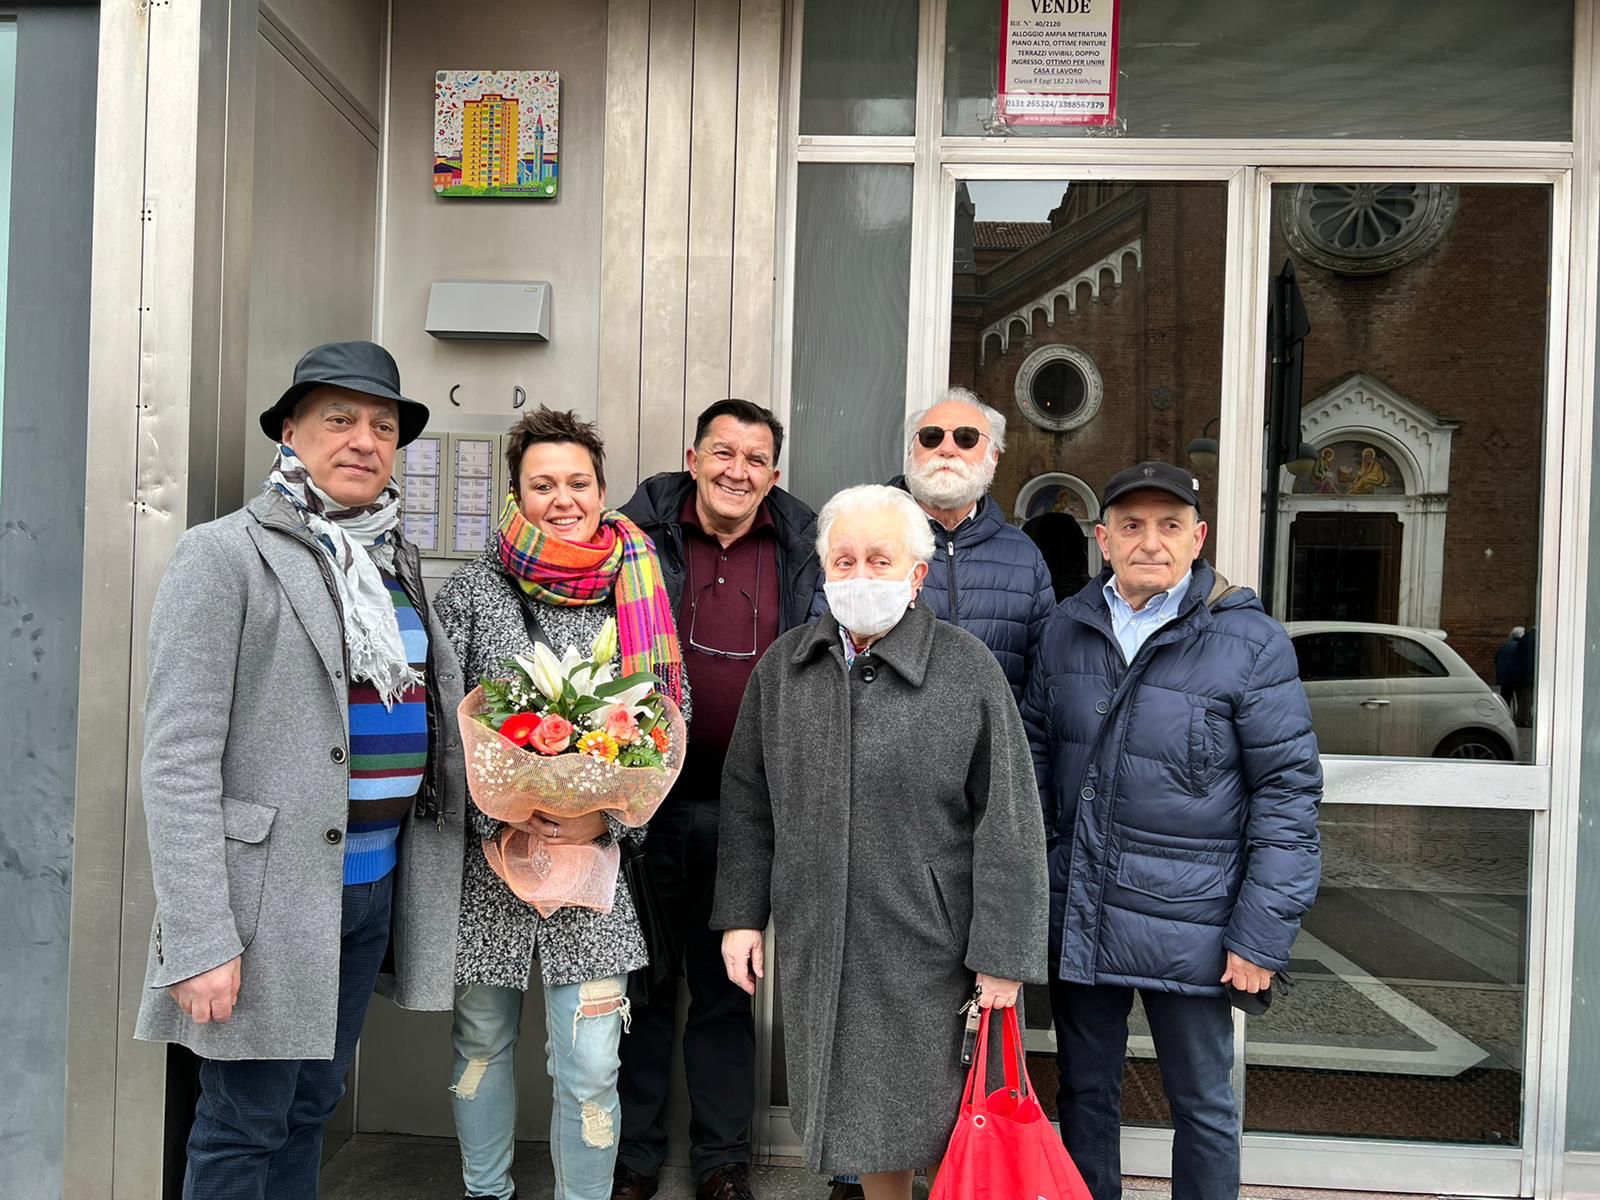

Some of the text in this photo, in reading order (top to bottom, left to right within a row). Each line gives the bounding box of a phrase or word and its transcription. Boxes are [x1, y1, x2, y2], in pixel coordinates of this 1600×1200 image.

[1031, 0, 1091, 13] VENDE
[450, 384, 460, 406] C
[513, 386, 526, 408] D
